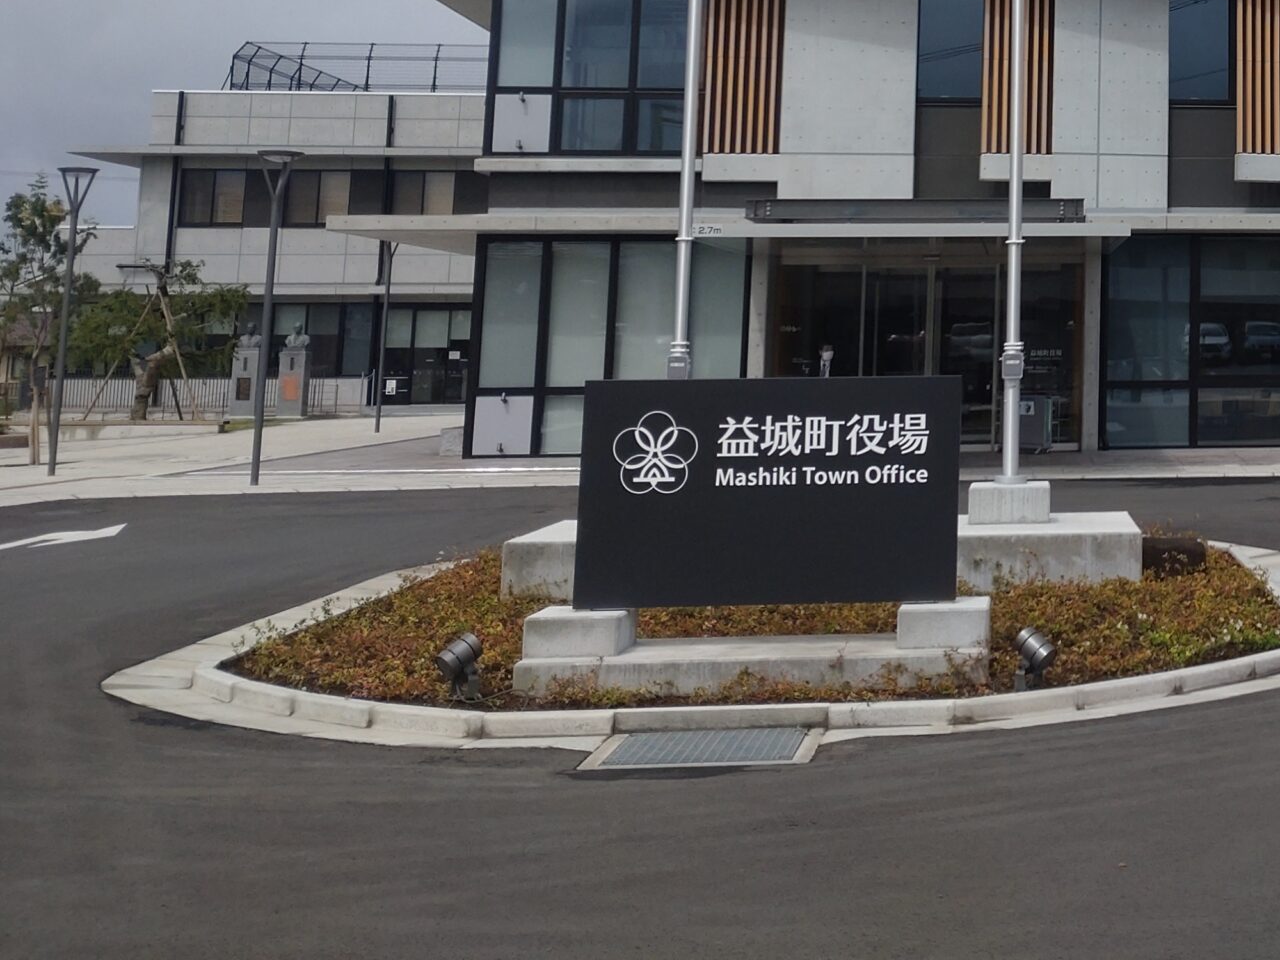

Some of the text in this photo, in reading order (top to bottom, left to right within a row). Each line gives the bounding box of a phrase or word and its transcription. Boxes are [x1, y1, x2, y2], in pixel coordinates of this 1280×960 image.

[717, 414, 929, 458] 益城町役場
[715, 464, 928, 486] Mashiki Town Office
